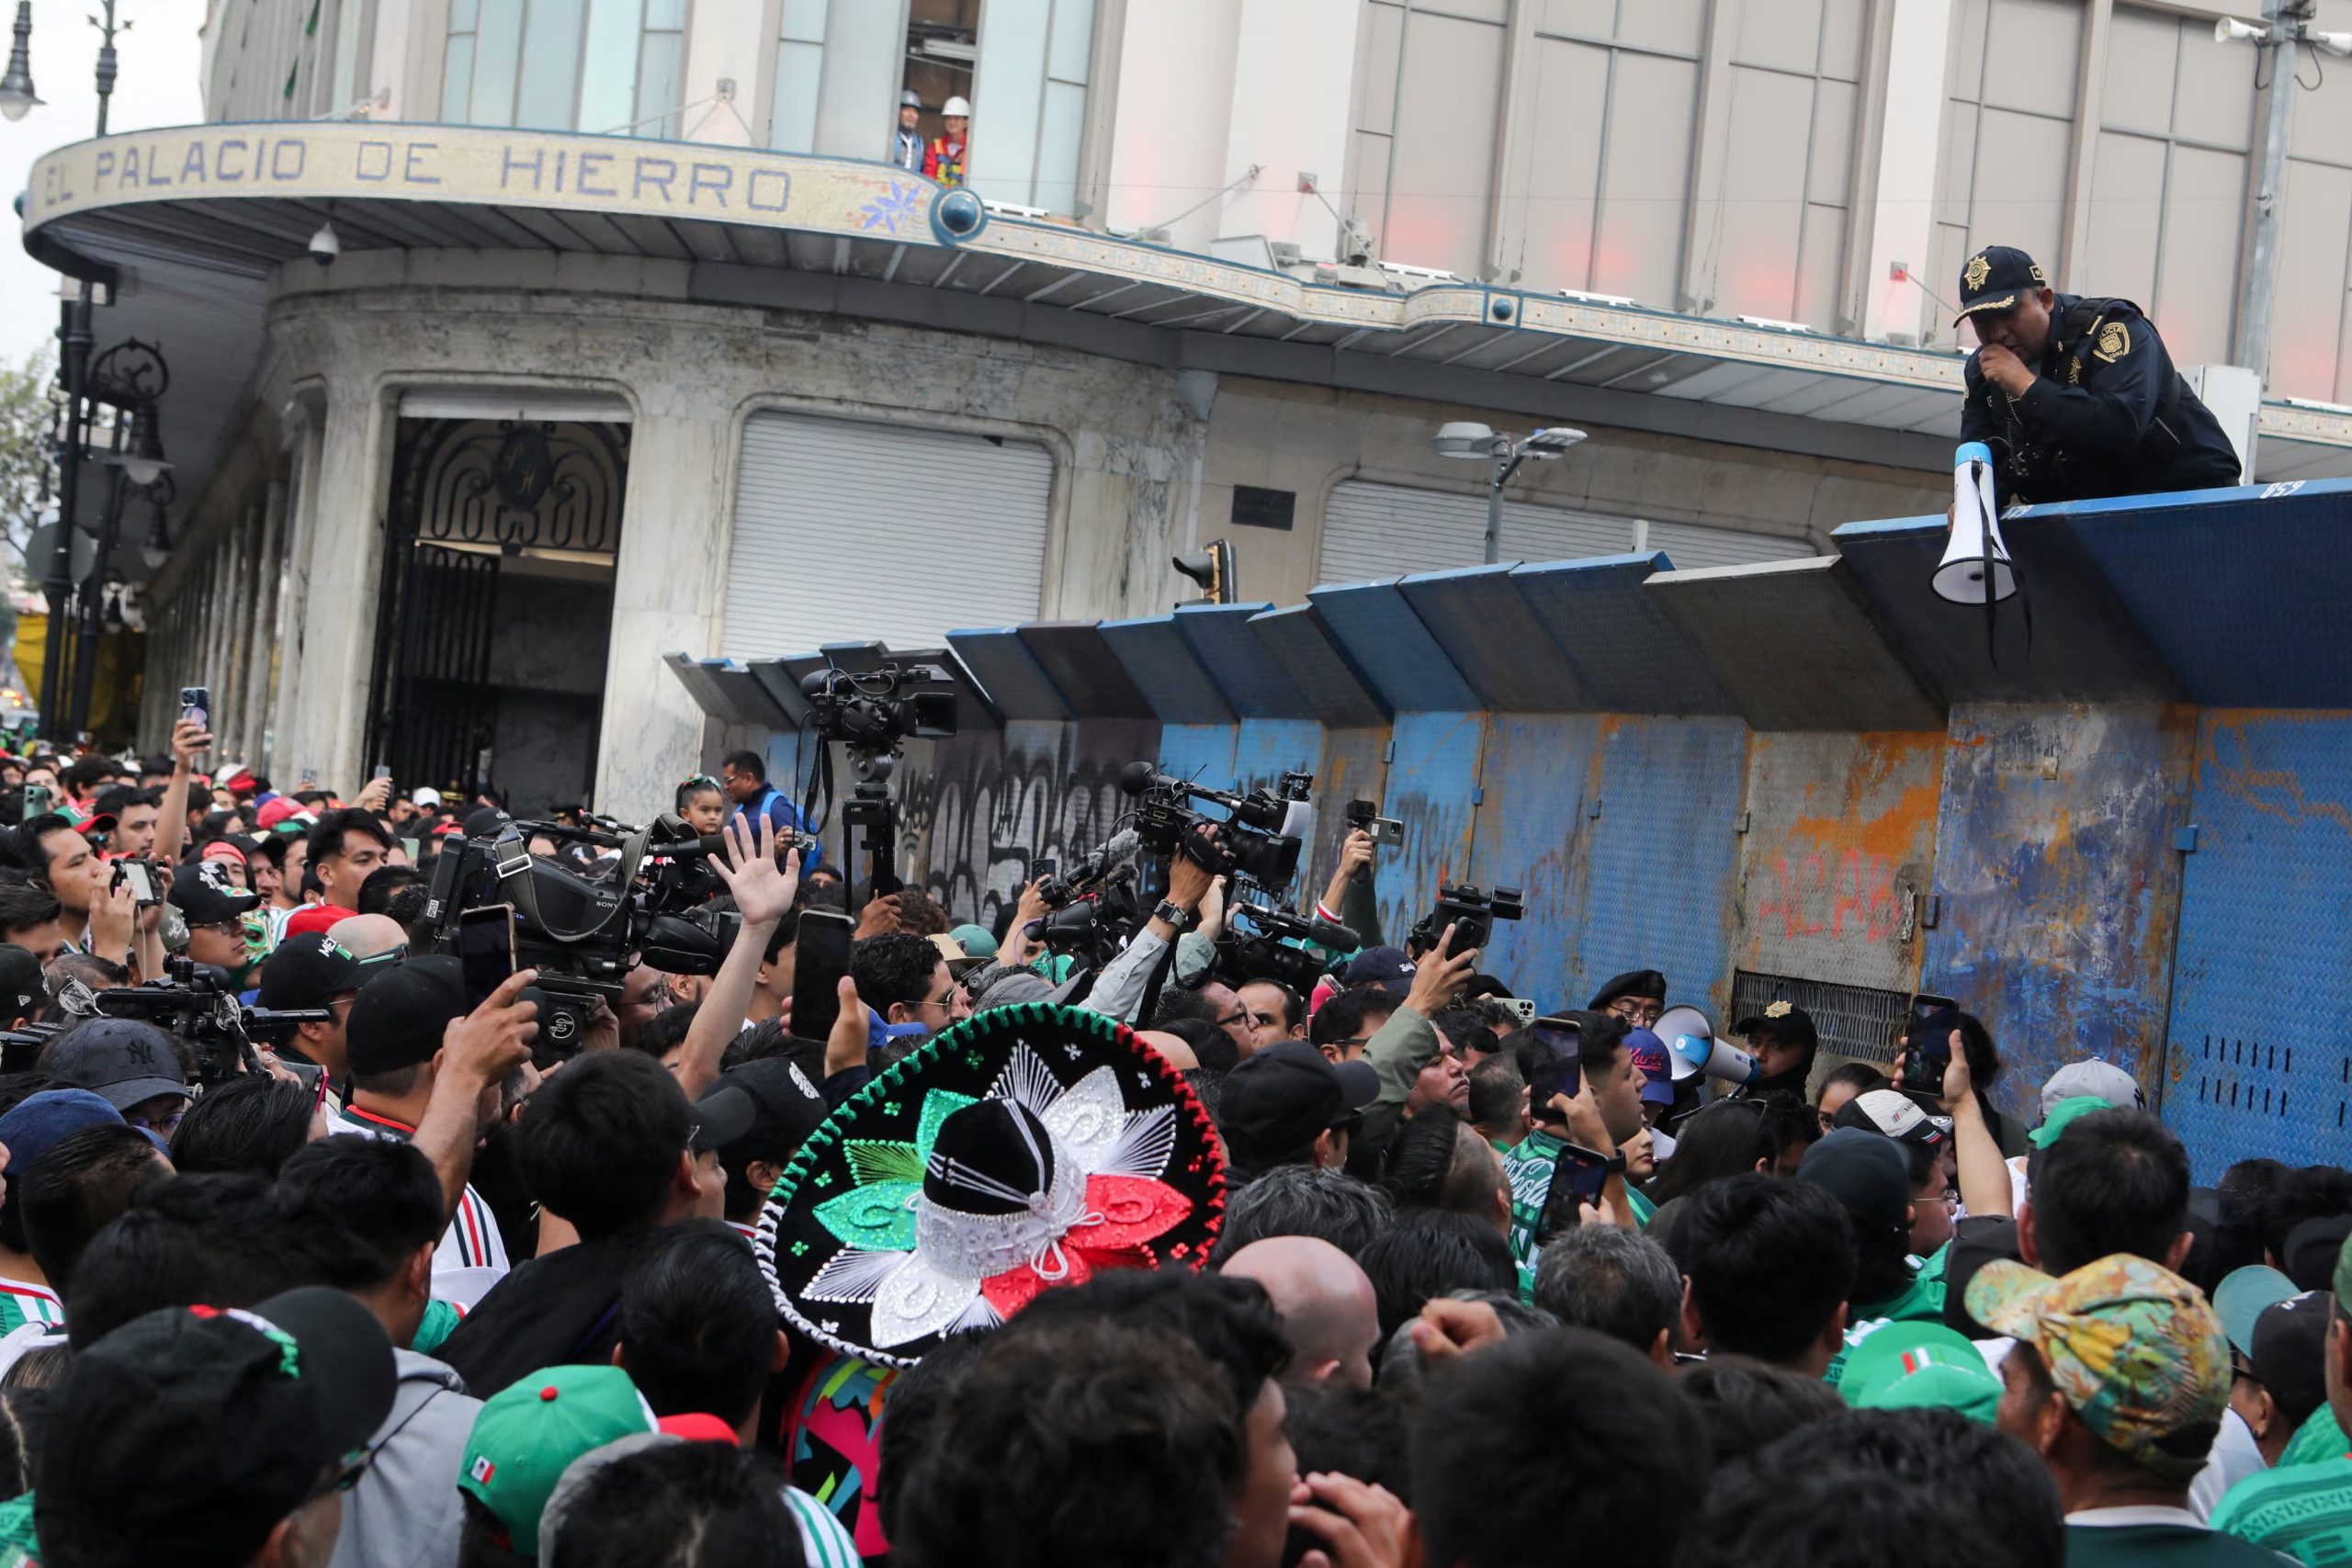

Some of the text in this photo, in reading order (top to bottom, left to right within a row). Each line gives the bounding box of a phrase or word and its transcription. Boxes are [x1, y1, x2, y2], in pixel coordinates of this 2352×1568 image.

[45, 140, 791, 213] EL PALACIO DE HIERRO
[595, 900, 618, 908] SONY
[1756, 847, 1900, 944] ACAB
